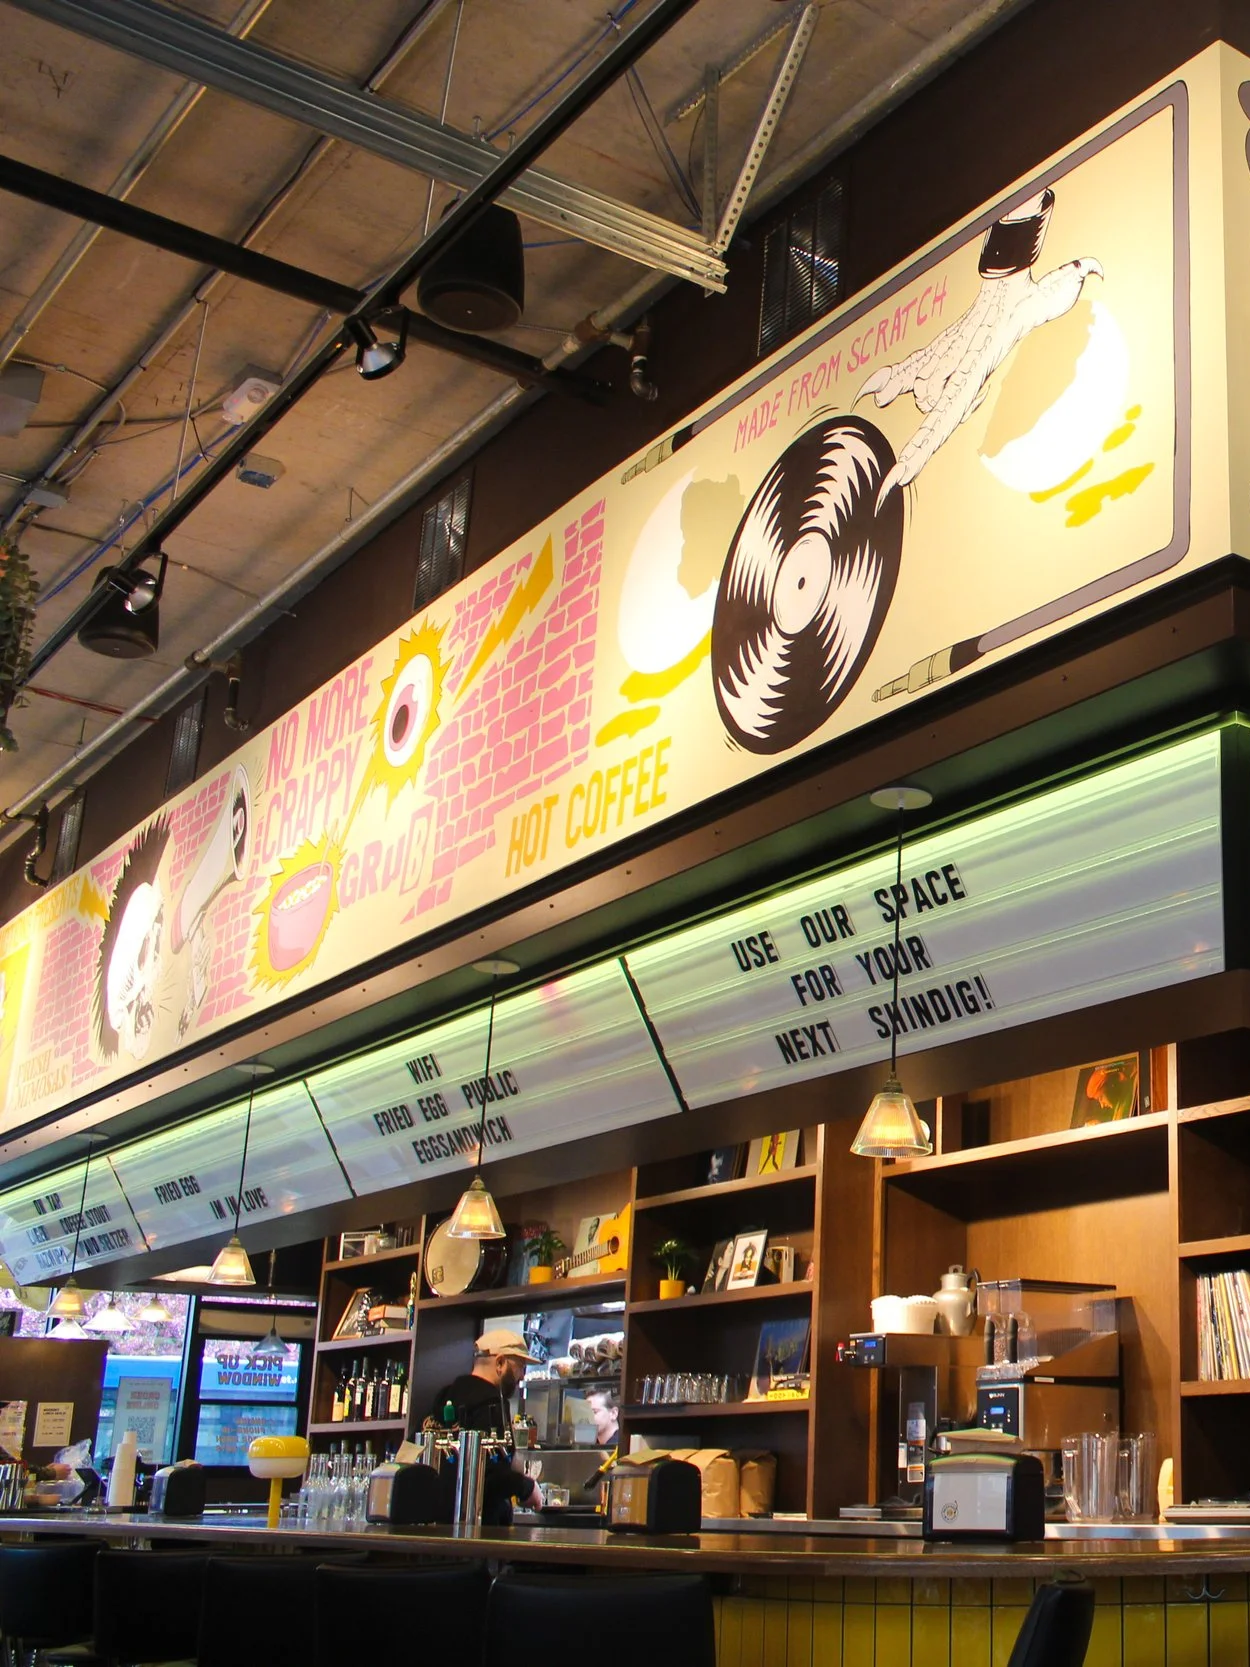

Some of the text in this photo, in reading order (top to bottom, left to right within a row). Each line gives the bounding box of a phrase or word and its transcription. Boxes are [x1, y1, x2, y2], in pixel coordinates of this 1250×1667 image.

[733, 274, 948, 454] MADE FROM SCRATCH
[265, 656, 374, 792] NO MORE
[262, 734, 363, 865] CRAPPY
[504, 736, 672, 878] HOT COFFEE
[731, 863, 966, 972] USE OUR SPACE
[790, 934, 931, 1007] FOR YOUR
[775, 975, 994, 1065] NEXT SHINDIG!
[373, 1069, 519, 1136] FRIED EGG PUBLIC
[405, 1053, 442, 1085] WIFI
[411, 1115, 512, 1165] EGGSANDWICH
[45, 1193, 64, 1211] TAP
[60, 1212, 89, 1235] COFFEE
[84, 1204, 112, 1228] STOUT
[154, 1175, 201, 1205] FRIED EGG
[210, 1199, 227, 1220] IM
[243, 1186, 269, 1212] LOVE
[97, 1227, 132, 1252] SELTZER
